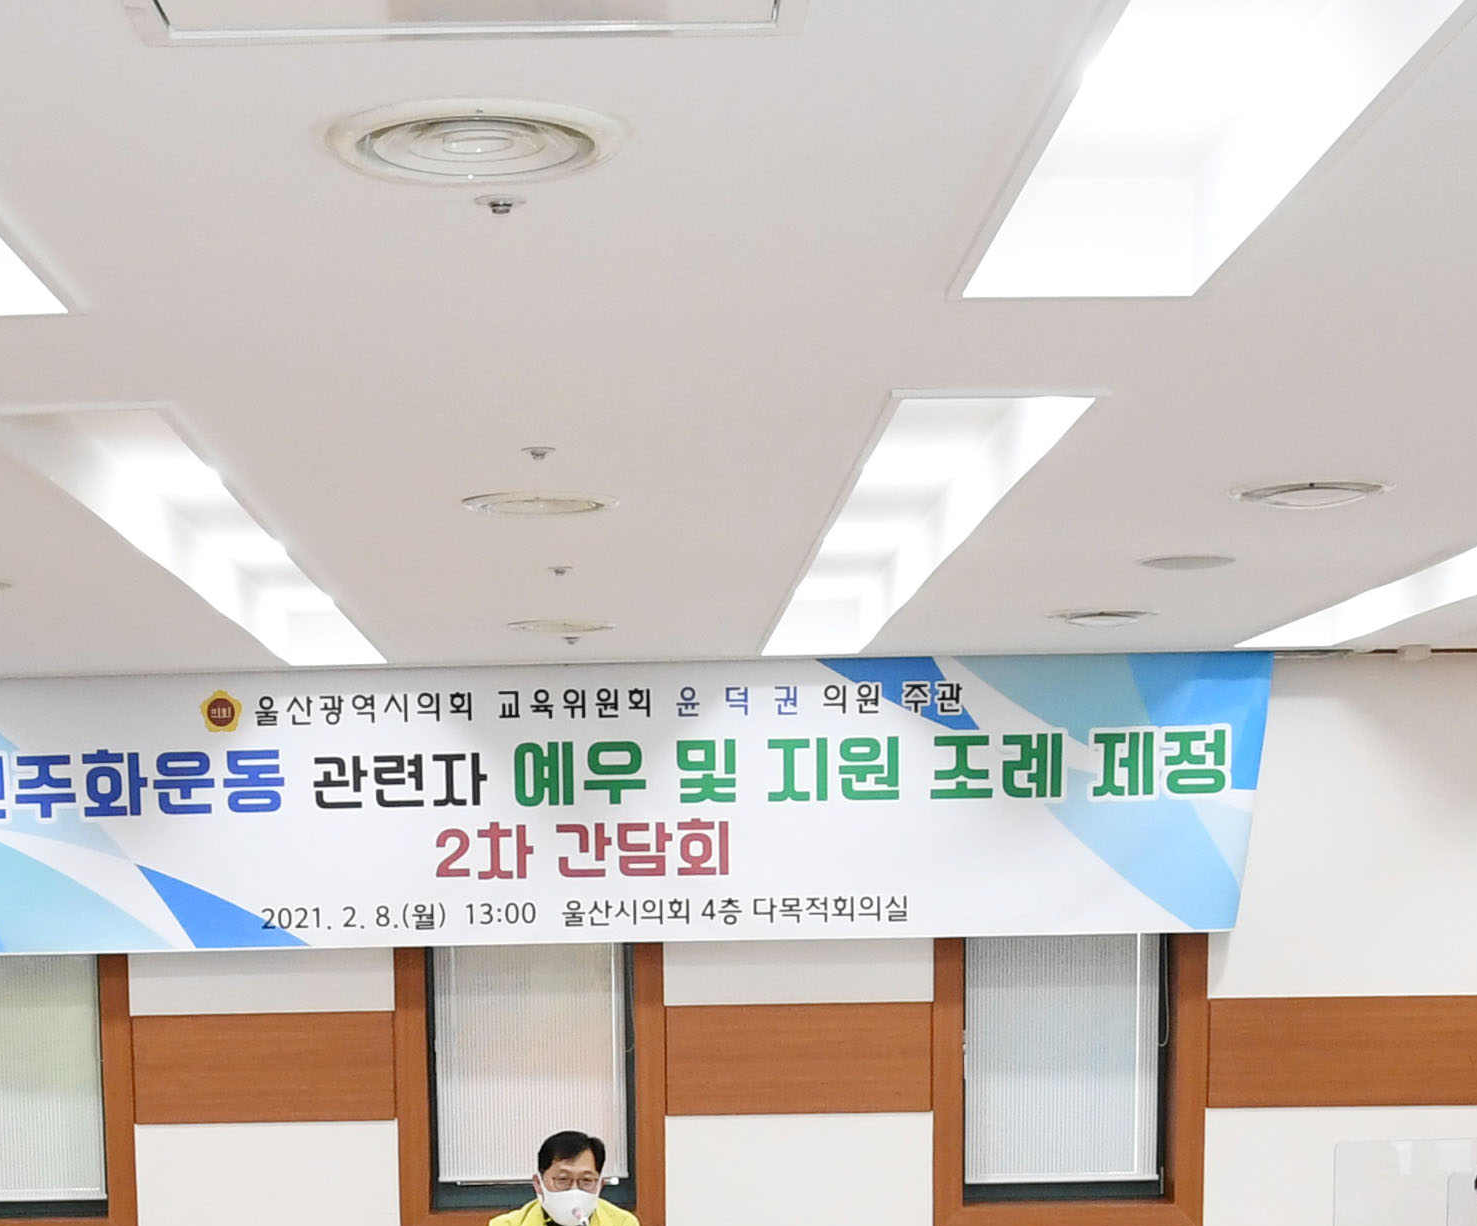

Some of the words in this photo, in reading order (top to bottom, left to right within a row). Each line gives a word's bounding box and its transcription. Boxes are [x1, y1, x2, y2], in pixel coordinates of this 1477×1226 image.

[254, 691, 473, 727] 울산광역시의회
[497, 687, 651, 720] 교육위원회
[676, 686, 700, 717] 윤
[725, 687, 748, 715] 덕
[774, 686, 797, 715] 권
[823, 684, 881, 714] 의원
[903, 682, 963, 715] 주관
[313, 752, 488, 809] 관련자
[513, 740, 647, 807] 예우
[676, 739, 736, 803] 및
[767, 736, 899, 802] 지원
[930, 732, 1063, 799] 조례
[1092, 730, 1226, 797] 제정
[435, 822, 534, 881] 2차
[555, 818, 730, 878] 간담회
[465, 902, 536, 925] 13:00
[561, 898, 690, 927] 울산시의회
[700, 898, 742, 925] 4층
[753, 896, 909, 923] 다목적회의실
